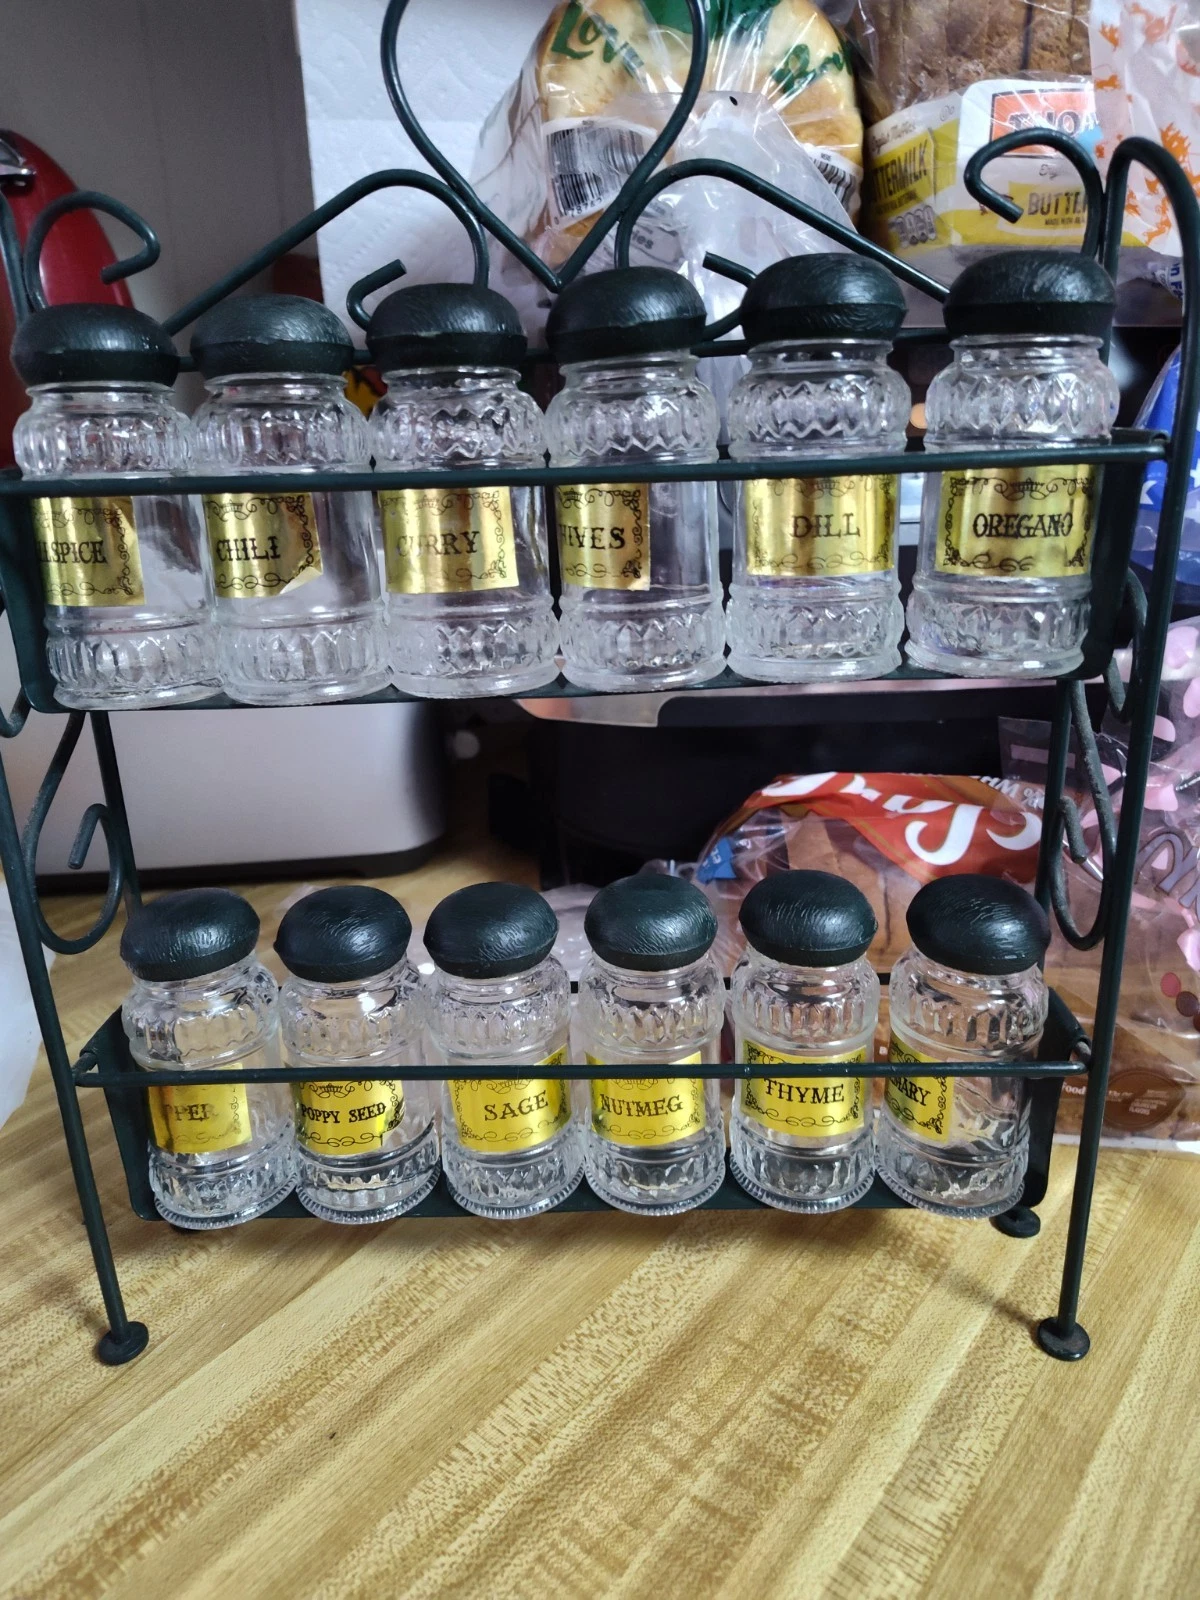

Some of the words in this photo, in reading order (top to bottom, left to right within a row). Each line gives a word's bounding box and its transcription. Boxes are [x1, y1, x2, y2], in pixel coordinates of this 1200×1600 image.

[558, 524, 626, 550] HIVES
[790, 512, 861, 539] DILL
[972, 512, 1074, 540] OREGANO
[216, 535, 281, 562] CHILI
[396, 530, 480, 558] CURRY
[483, 1089, 549, 1122] SAGE
[598, 1093, 685, 1118] NUTMEG
[763, 1078, 845, 1106] THYME
[300, 1103, 341, 1124] POPPY
[348, 1102, 388, 1124] SEED
